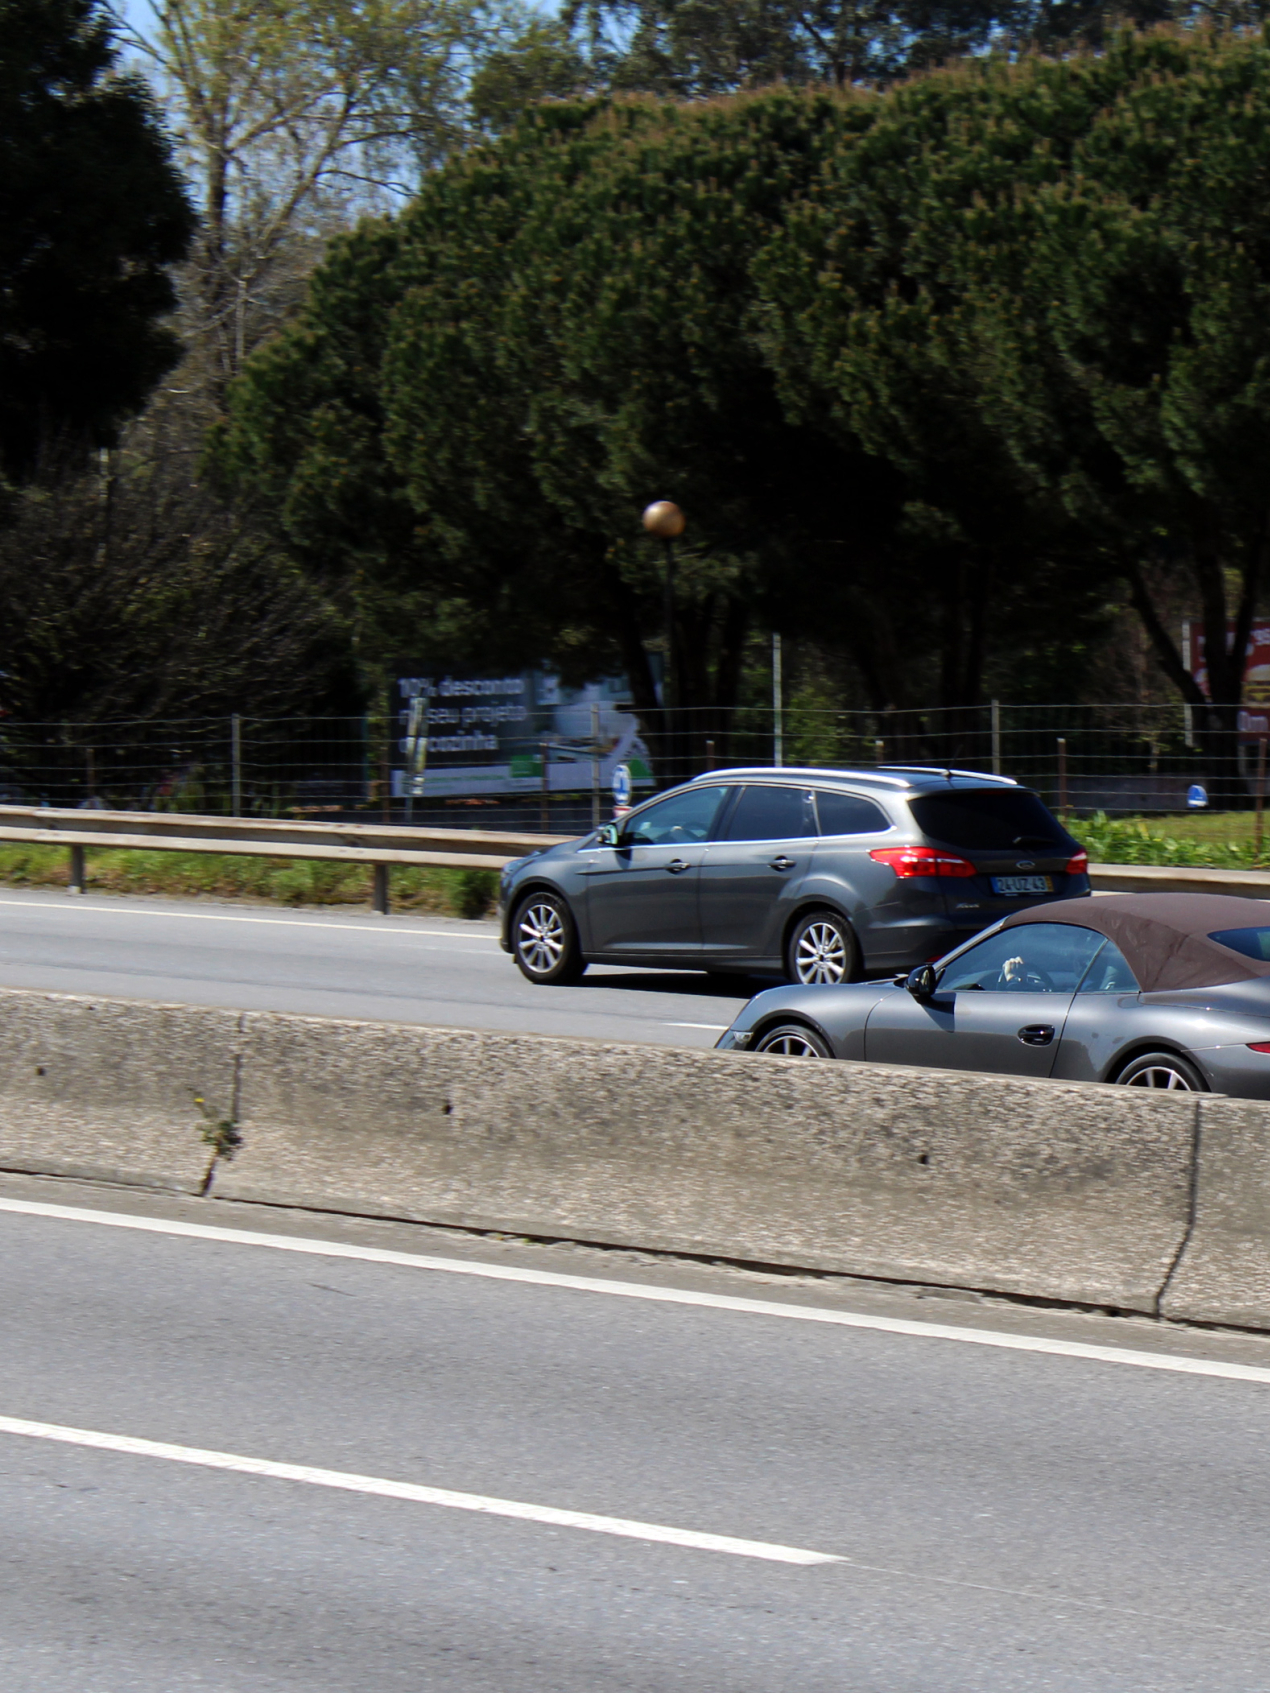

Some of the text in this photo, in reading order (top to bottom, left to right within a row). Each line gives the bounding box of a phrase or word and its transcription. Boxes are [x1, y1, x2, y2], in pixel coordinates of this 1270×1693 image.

[398, 675, 525, 698] 10% desconto
[425, 708, 460, 725] seu
[461, 701, 527, 728] projeto
[426, 730, 499, 753] cozinha
